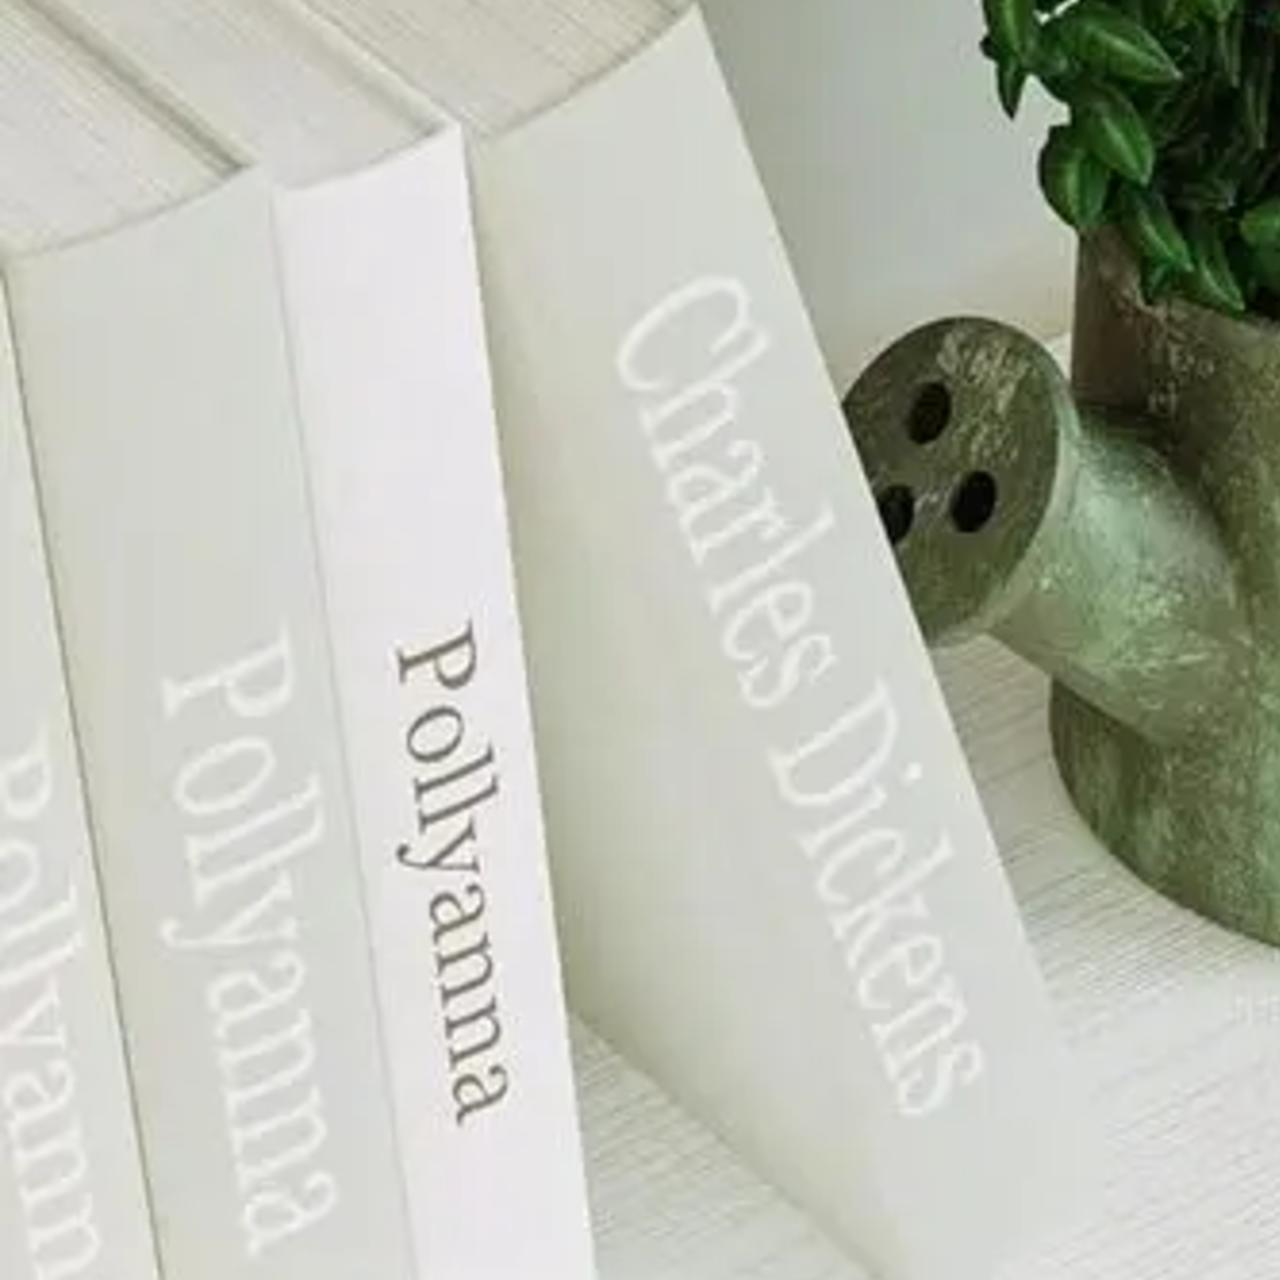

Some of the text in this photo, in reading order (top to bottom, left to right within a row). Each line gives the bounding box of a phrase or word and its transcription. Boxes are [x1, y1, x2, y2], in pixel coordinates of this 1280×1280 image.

[162, 626, 340, 1258] Pollyanna
[393, 620, 511, 1127] Pollyanna
[613, 272, 985, 1118] Charles Dickens
